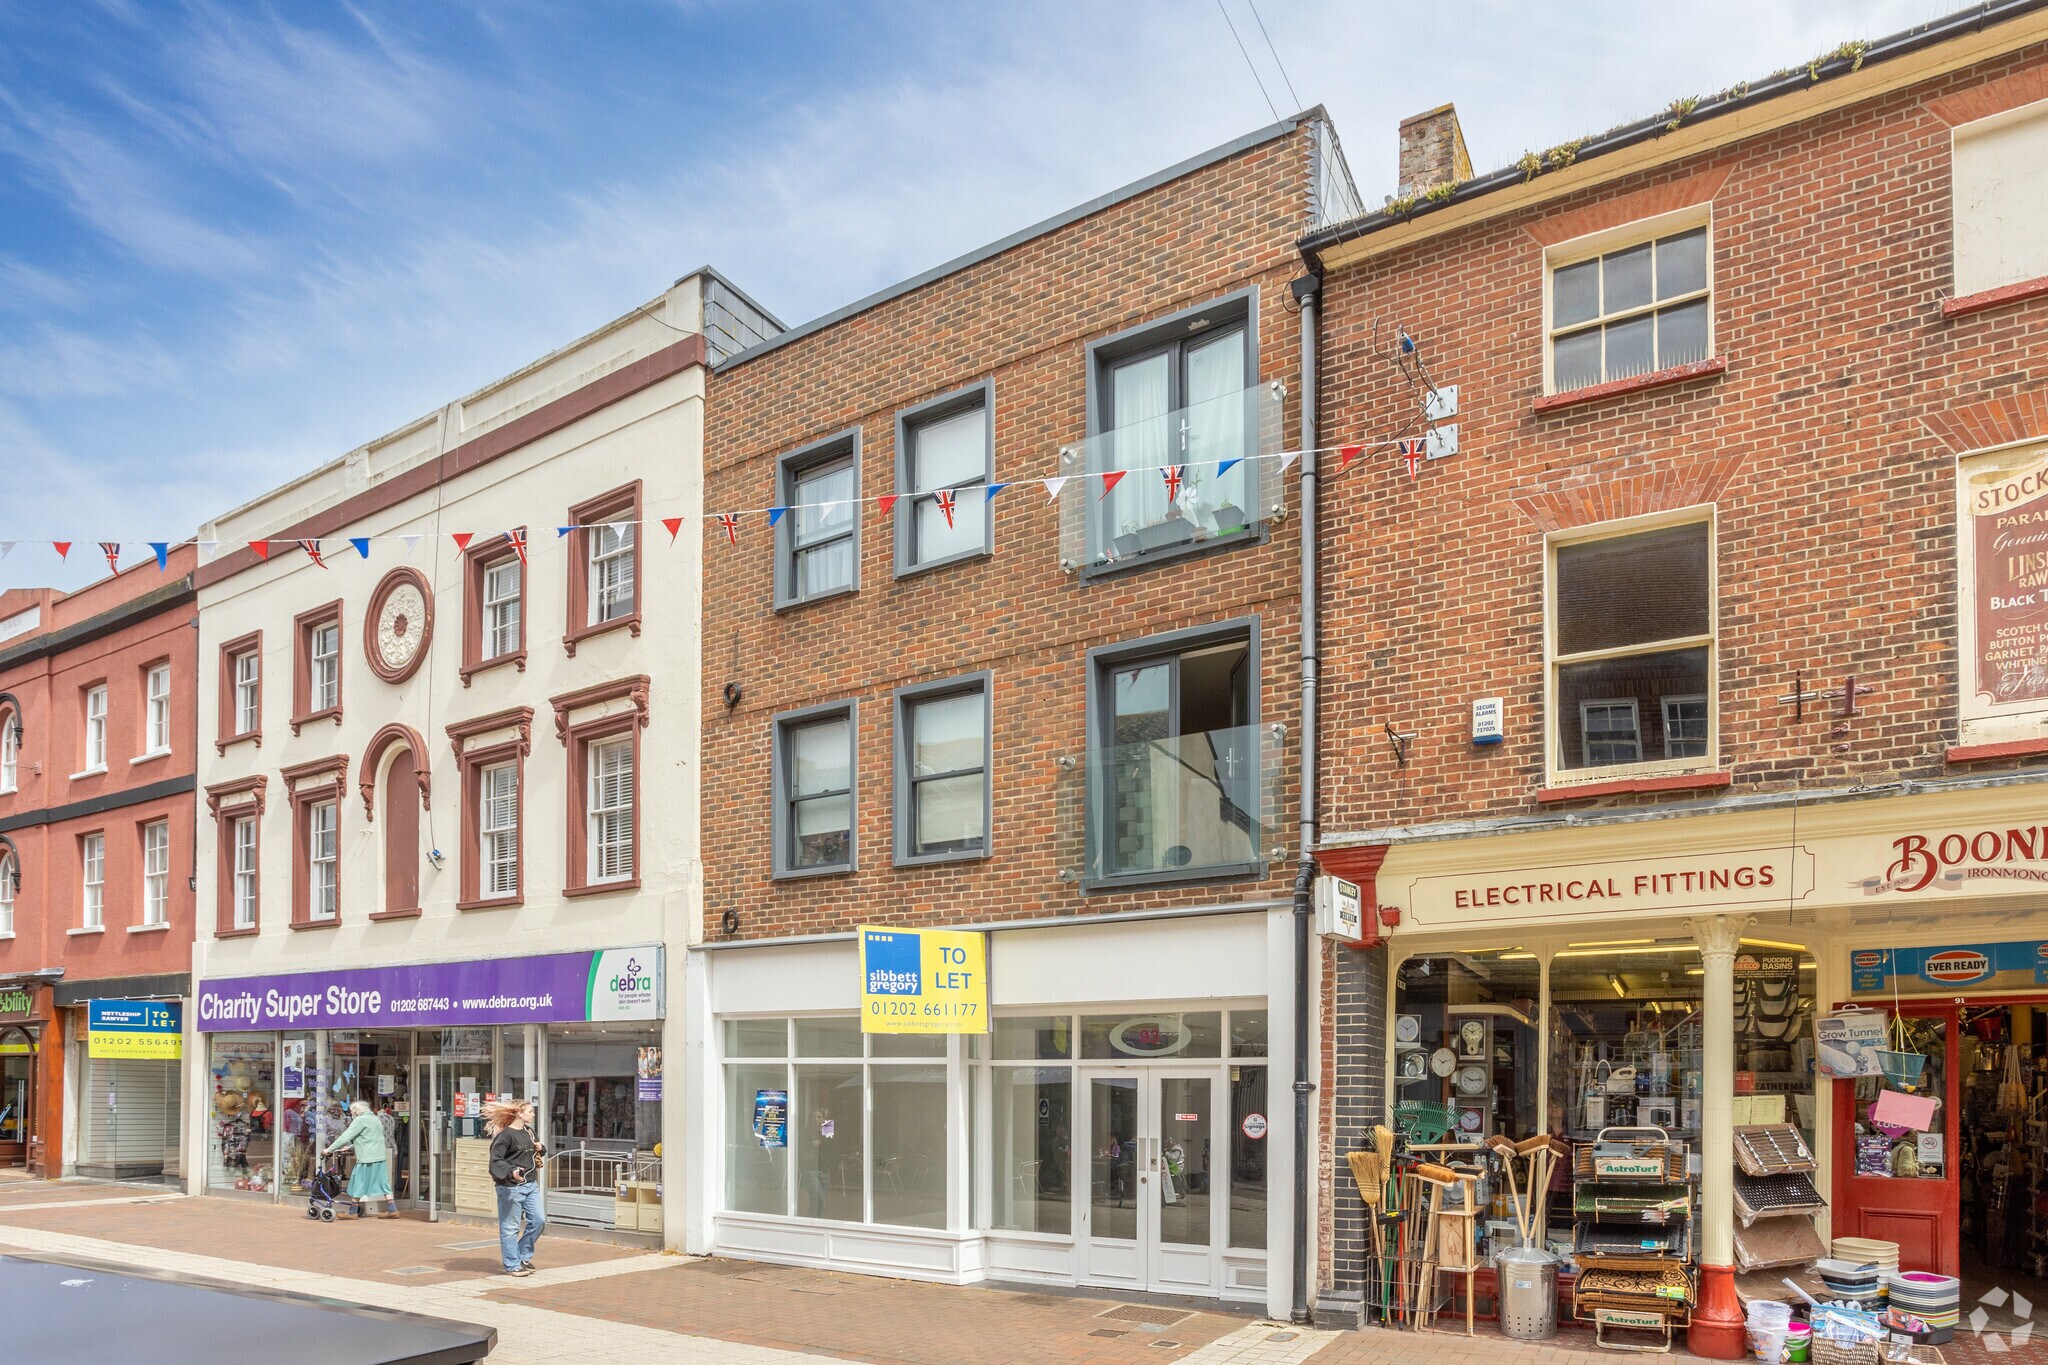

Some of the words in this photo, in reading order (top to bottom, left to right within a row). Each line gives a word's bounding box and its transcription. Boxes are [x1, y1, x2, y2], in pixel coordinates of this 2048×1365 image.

[1997, 510, 2048, 530] PARA
[2008, 550, 2048, 582] LINS
[1996, 624, 2041, 638] SCOTCH
[1990, 635, 2035, 650] BUTTON
[2040, 633, 2048, 643] P
[1985, 646, 2035, 662] GARNET
[1996, 656, 2048, 671] WHITING
[1476, 703, 1496, 711] SECURE
[1454, 878, 1621, 909] ELECTRICAL
[1634, 864, 1775, 896] FITTINGS
[939, 946, 967, 965] TO
[1927, 962, 1952, 972] EVER
[1953, 960, 1987, 970] READY
[610, 974, 651, 992] debra
[870, 969, 918, 982] sibbett
[935, 971, 972, 989] LET
[869, 981, 918, 994] gregory
[200, 992, 263, 1024] Charity
[265, 989, 322, 1022] Super
[325, 985, 382, 1015] Store
[390, 999, 416, 1012] 01202
[417, 998, 450, 1012] 687443
[462, 993, 553, 1011] www.debra.org.uk
[872, 1001, 917, 1015] 01202
[924, 1002, 977, 1016] 661177
[152, 1010, 169, 1019] TO
[886, 1020, 964, 1028] www.sibbettgregory.com
[94, 1037, 132, 1045] 01202
[138, 1038, 182, 1046] 556491
[1140, 1029, 1160, 1044] 93
[1818, 1031, 1846, 1040] Grow
[1849, 1028, 1883, 1038] Tunnel
[1756, 1082, 1812, 1090] EATHERMAN
[1605, 1165, 1658, 1173] AstroTurf
[1606, 1315, 1660, 1325] AstroTurf
